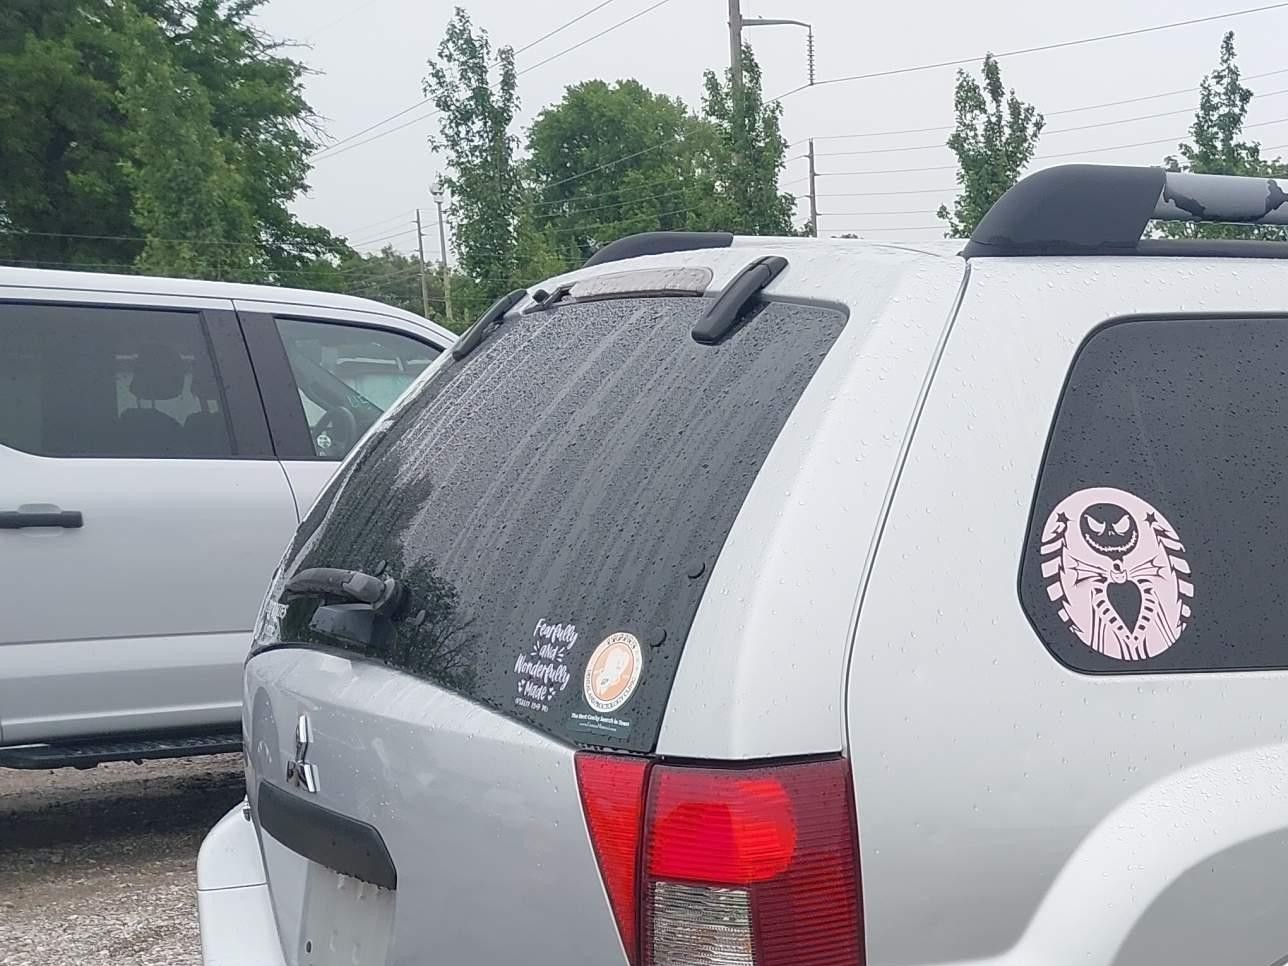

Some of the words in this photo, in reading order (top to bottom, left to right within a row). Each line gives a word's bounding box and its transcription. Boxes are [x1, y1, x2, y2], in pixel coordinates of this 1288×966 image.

[533, 618, 578, 649] Fearfully
[514, 653, 570, 691] Wonderfully
[524, 681, 547, 700] Made
